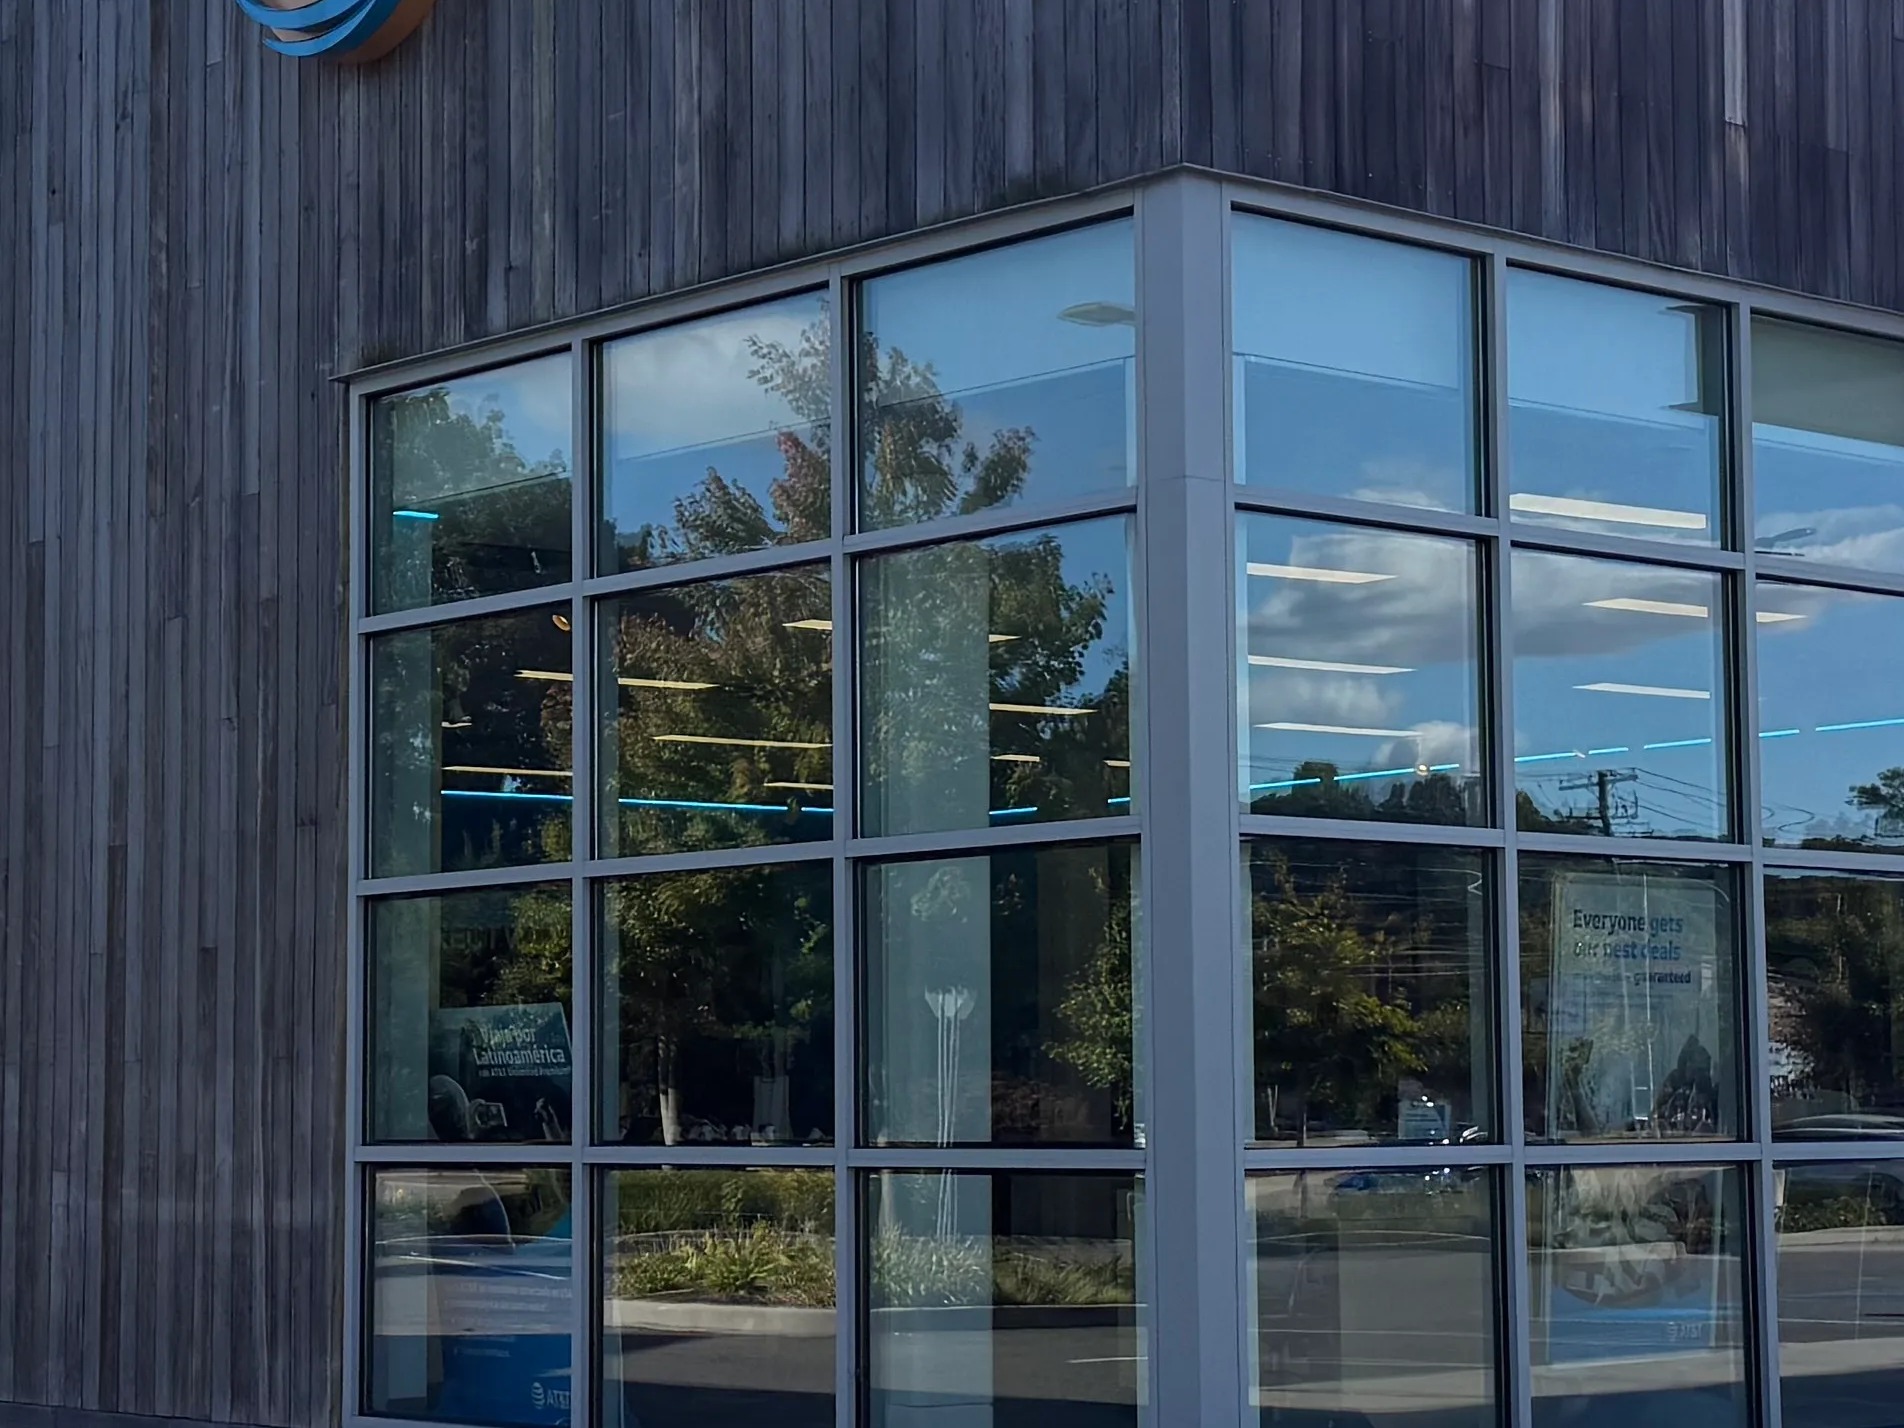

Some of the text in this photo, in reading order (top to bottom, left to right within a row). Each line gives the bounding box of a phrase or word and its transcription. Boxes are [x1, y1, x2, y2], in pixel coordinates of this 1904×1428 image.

[1573, 909, 1684, 937] Everyone gets
[472, 1044, 566, 1065] Latinoamérica
